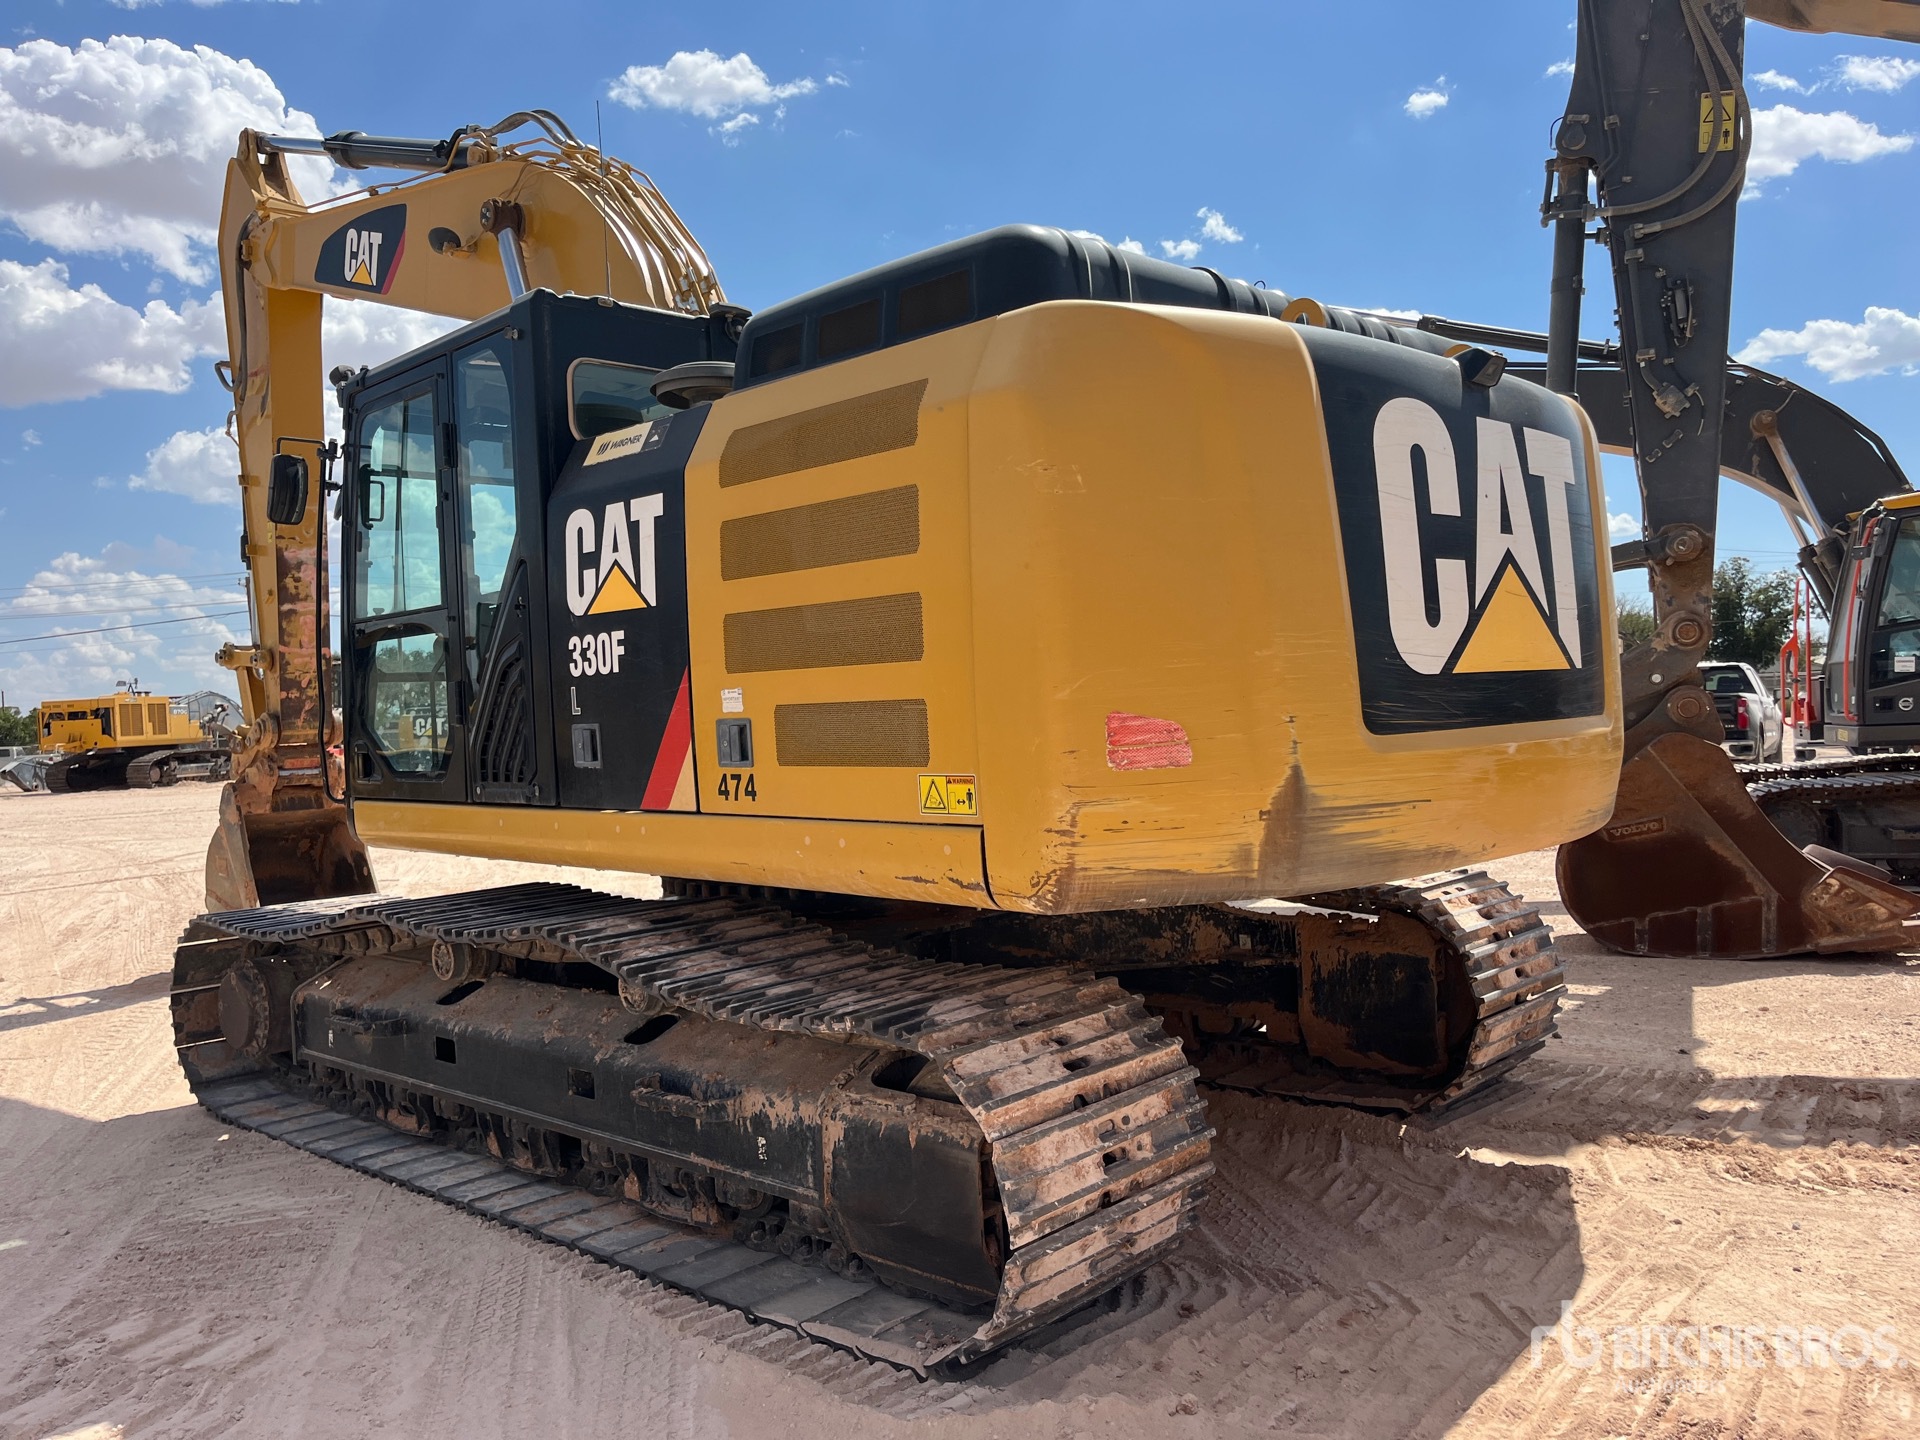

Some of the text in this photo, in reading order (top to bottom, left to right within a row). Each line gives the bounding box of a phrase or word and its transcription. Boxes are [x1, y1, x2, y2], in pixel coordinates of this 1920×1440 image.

[344, 228, 382, 286] CAT
[610, 434, 643, 451] WAGNER
[565, 493, 664, 616] CAT
[1373, 397, 1582, 675] CAT
[568, 630, 625, 677] 330F
[570, 686, 582, 715] L
[717, 773, 757, 802] 474
[1609, 821, 1660, 837] VOLVO
